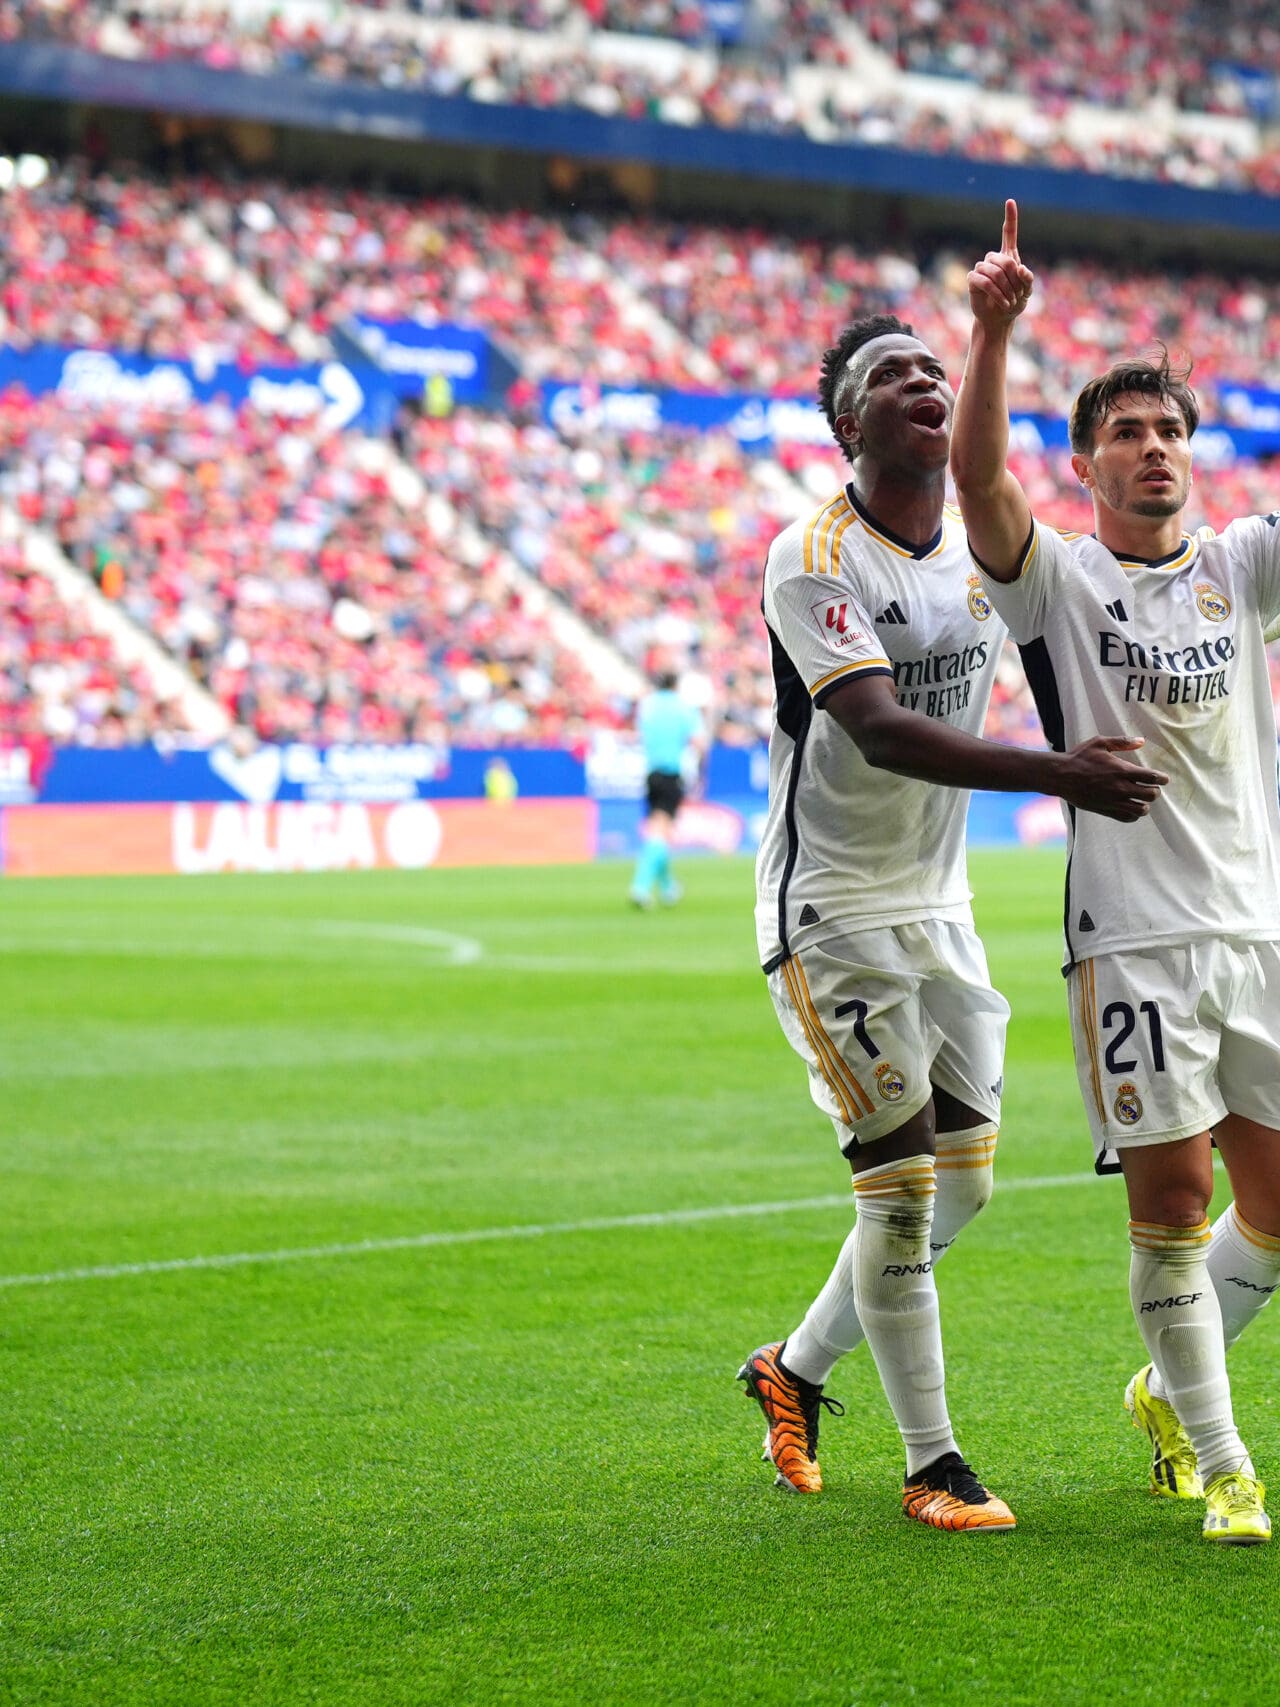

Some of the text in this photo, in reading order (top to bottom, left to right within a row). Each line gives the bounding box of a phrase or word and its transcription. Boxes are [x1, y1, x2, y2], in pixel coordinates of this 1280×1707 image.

[834, 632, 864, 648] LALIGA
[888, 641, 987, 687] mirates
[926, 680, 970, 717] BETTER
[1125, 670, 1229, 704] FLY BETTER
[172, 801, 377, 874] LALIGA
[834, 999, 881, 1059] 7
[1102, 1001, 1165, 1074] 21
[882, 1261, 932, 1276] RMC
[1140, 1292, 1203, 1313] RMCF
